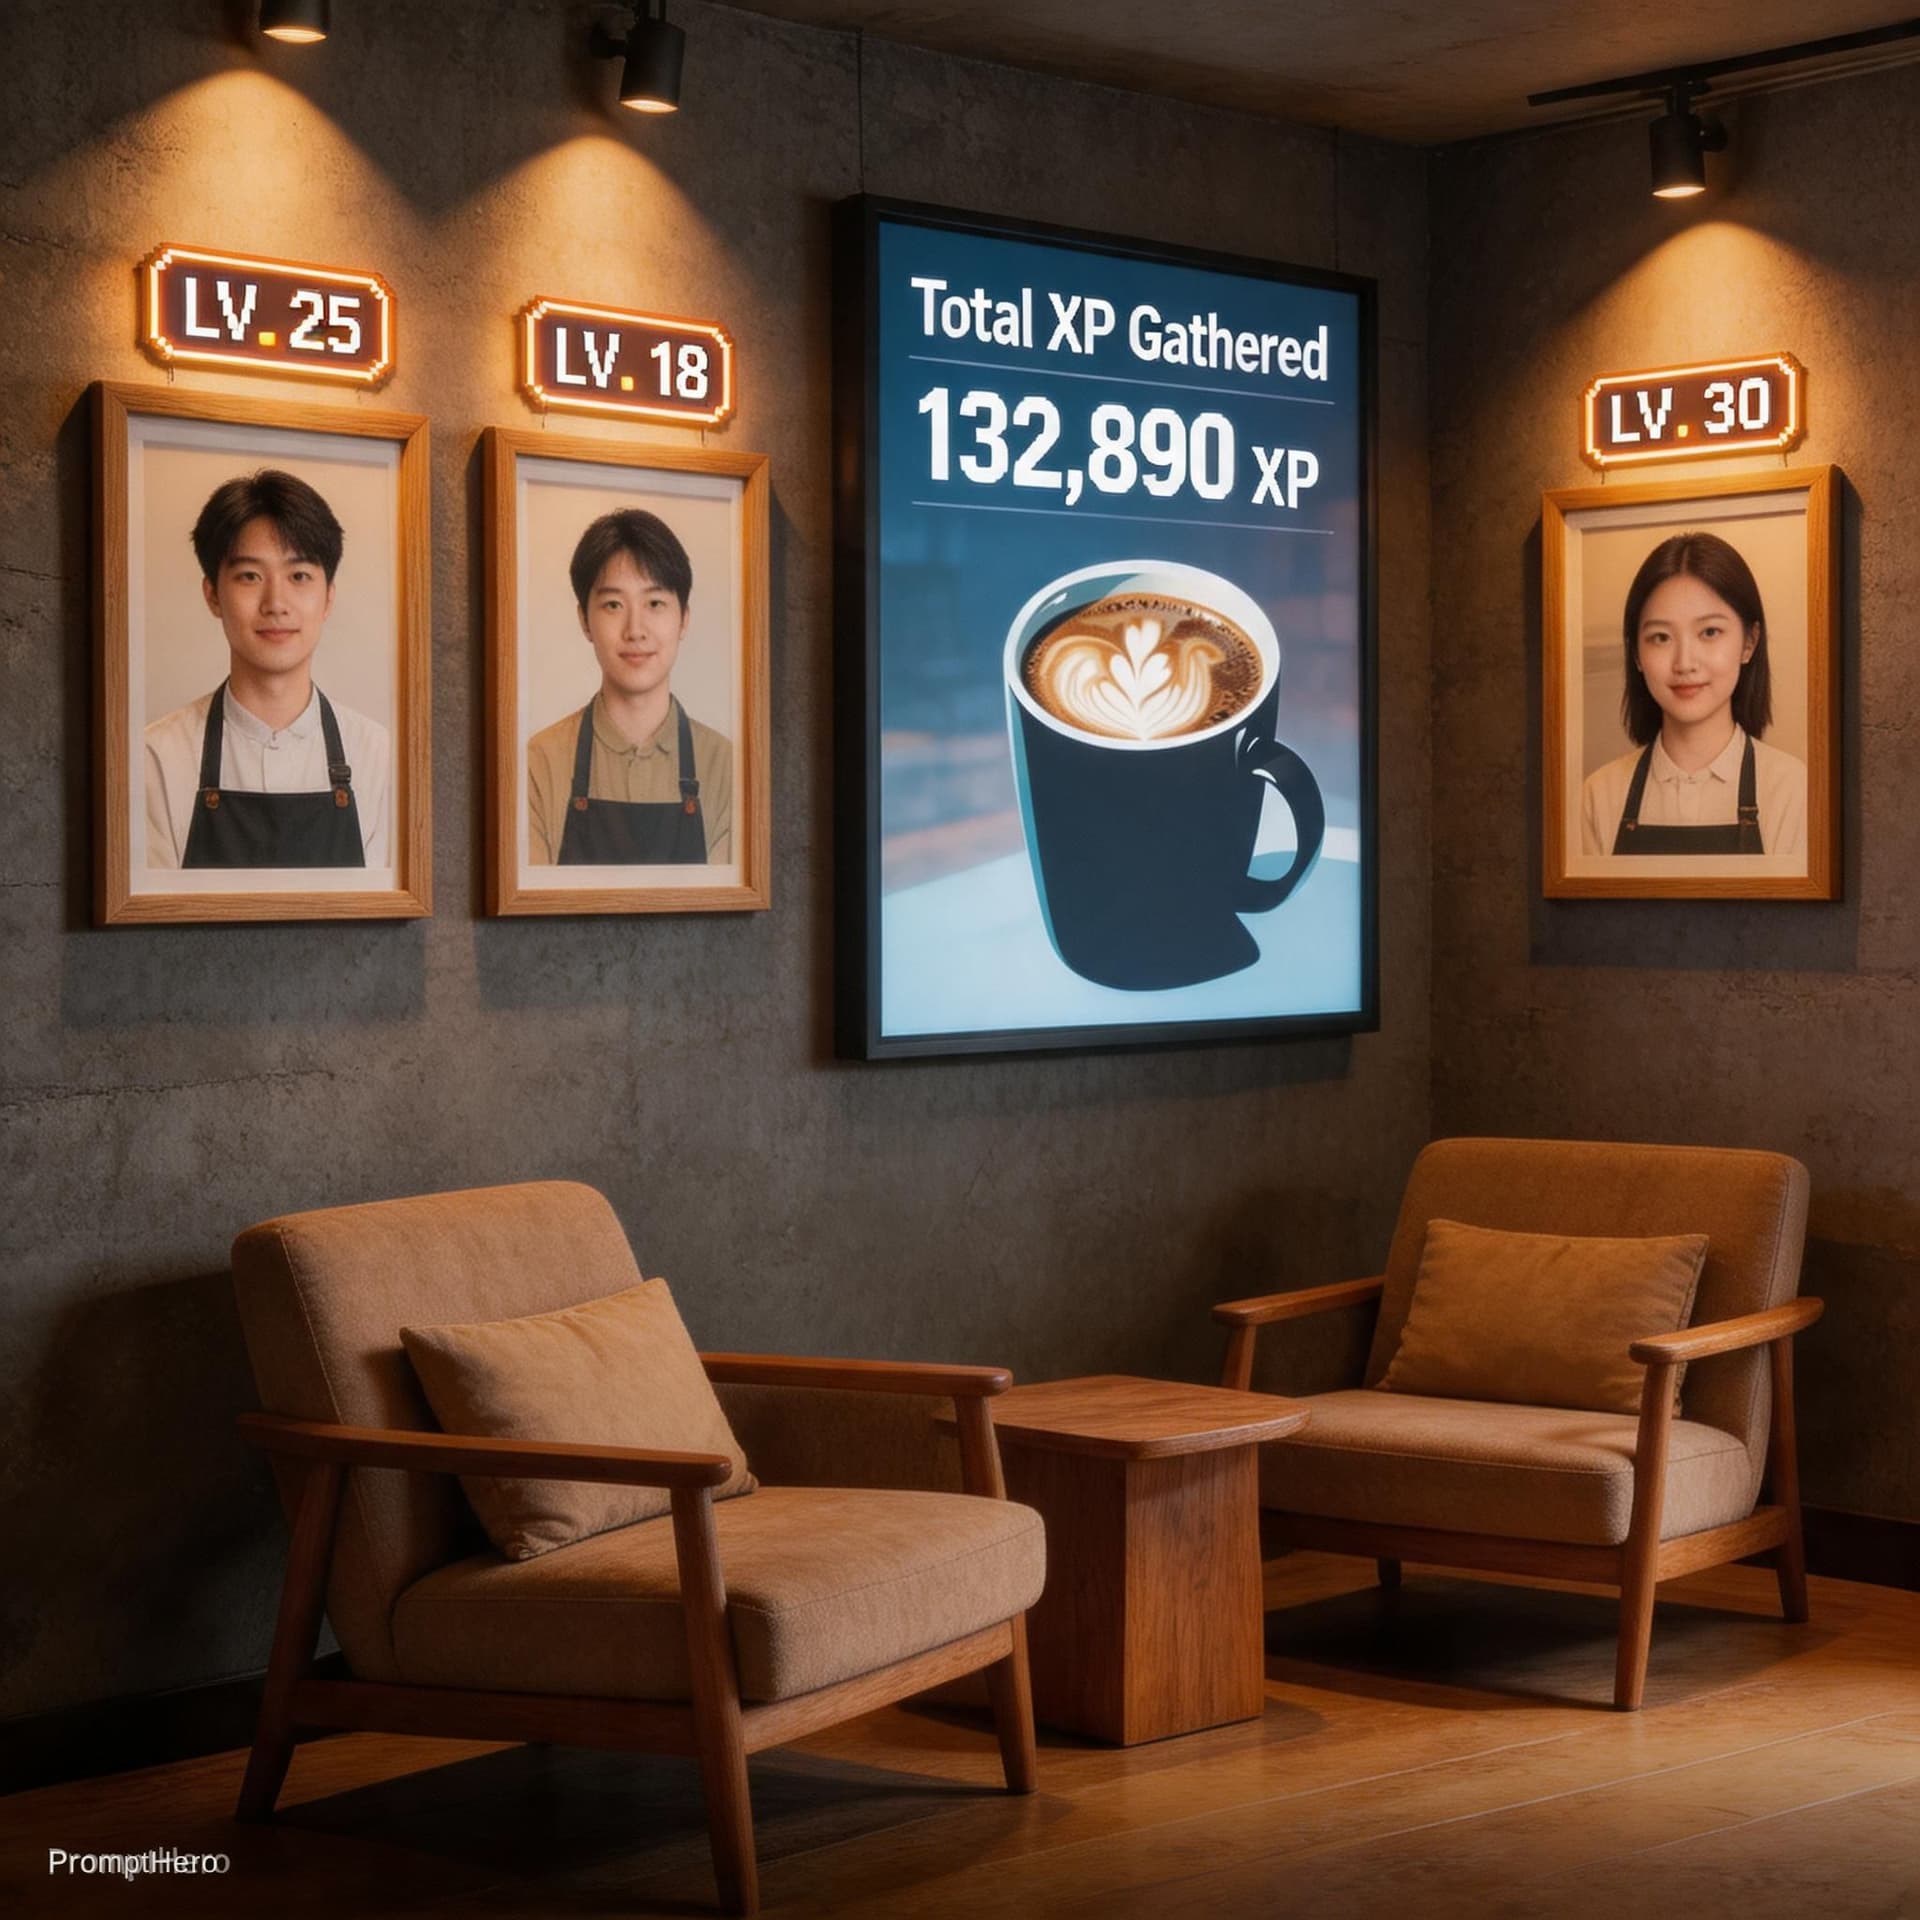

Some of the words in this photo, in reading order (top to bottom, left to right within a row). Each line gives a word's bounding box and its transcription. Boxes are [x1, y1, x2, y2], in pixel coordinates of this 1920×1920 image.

[184, 276, 277, 347] LV.
[288, 289, 362, 354] 25
[910, 276, 1034, 349] Total
[1046, 292, 1116, 355] XP
[1128, 304, 1329, 381] Gathered
[554, 326, 635, 391] LV.
[649, 340, 709, 400] 18
[917, 386, 1236, 506] 132,890
[1250, 445, 1320, 509] XP
[1610, 387, 1689, 443] LV.
[1703, 376, 1770, 434] 30
